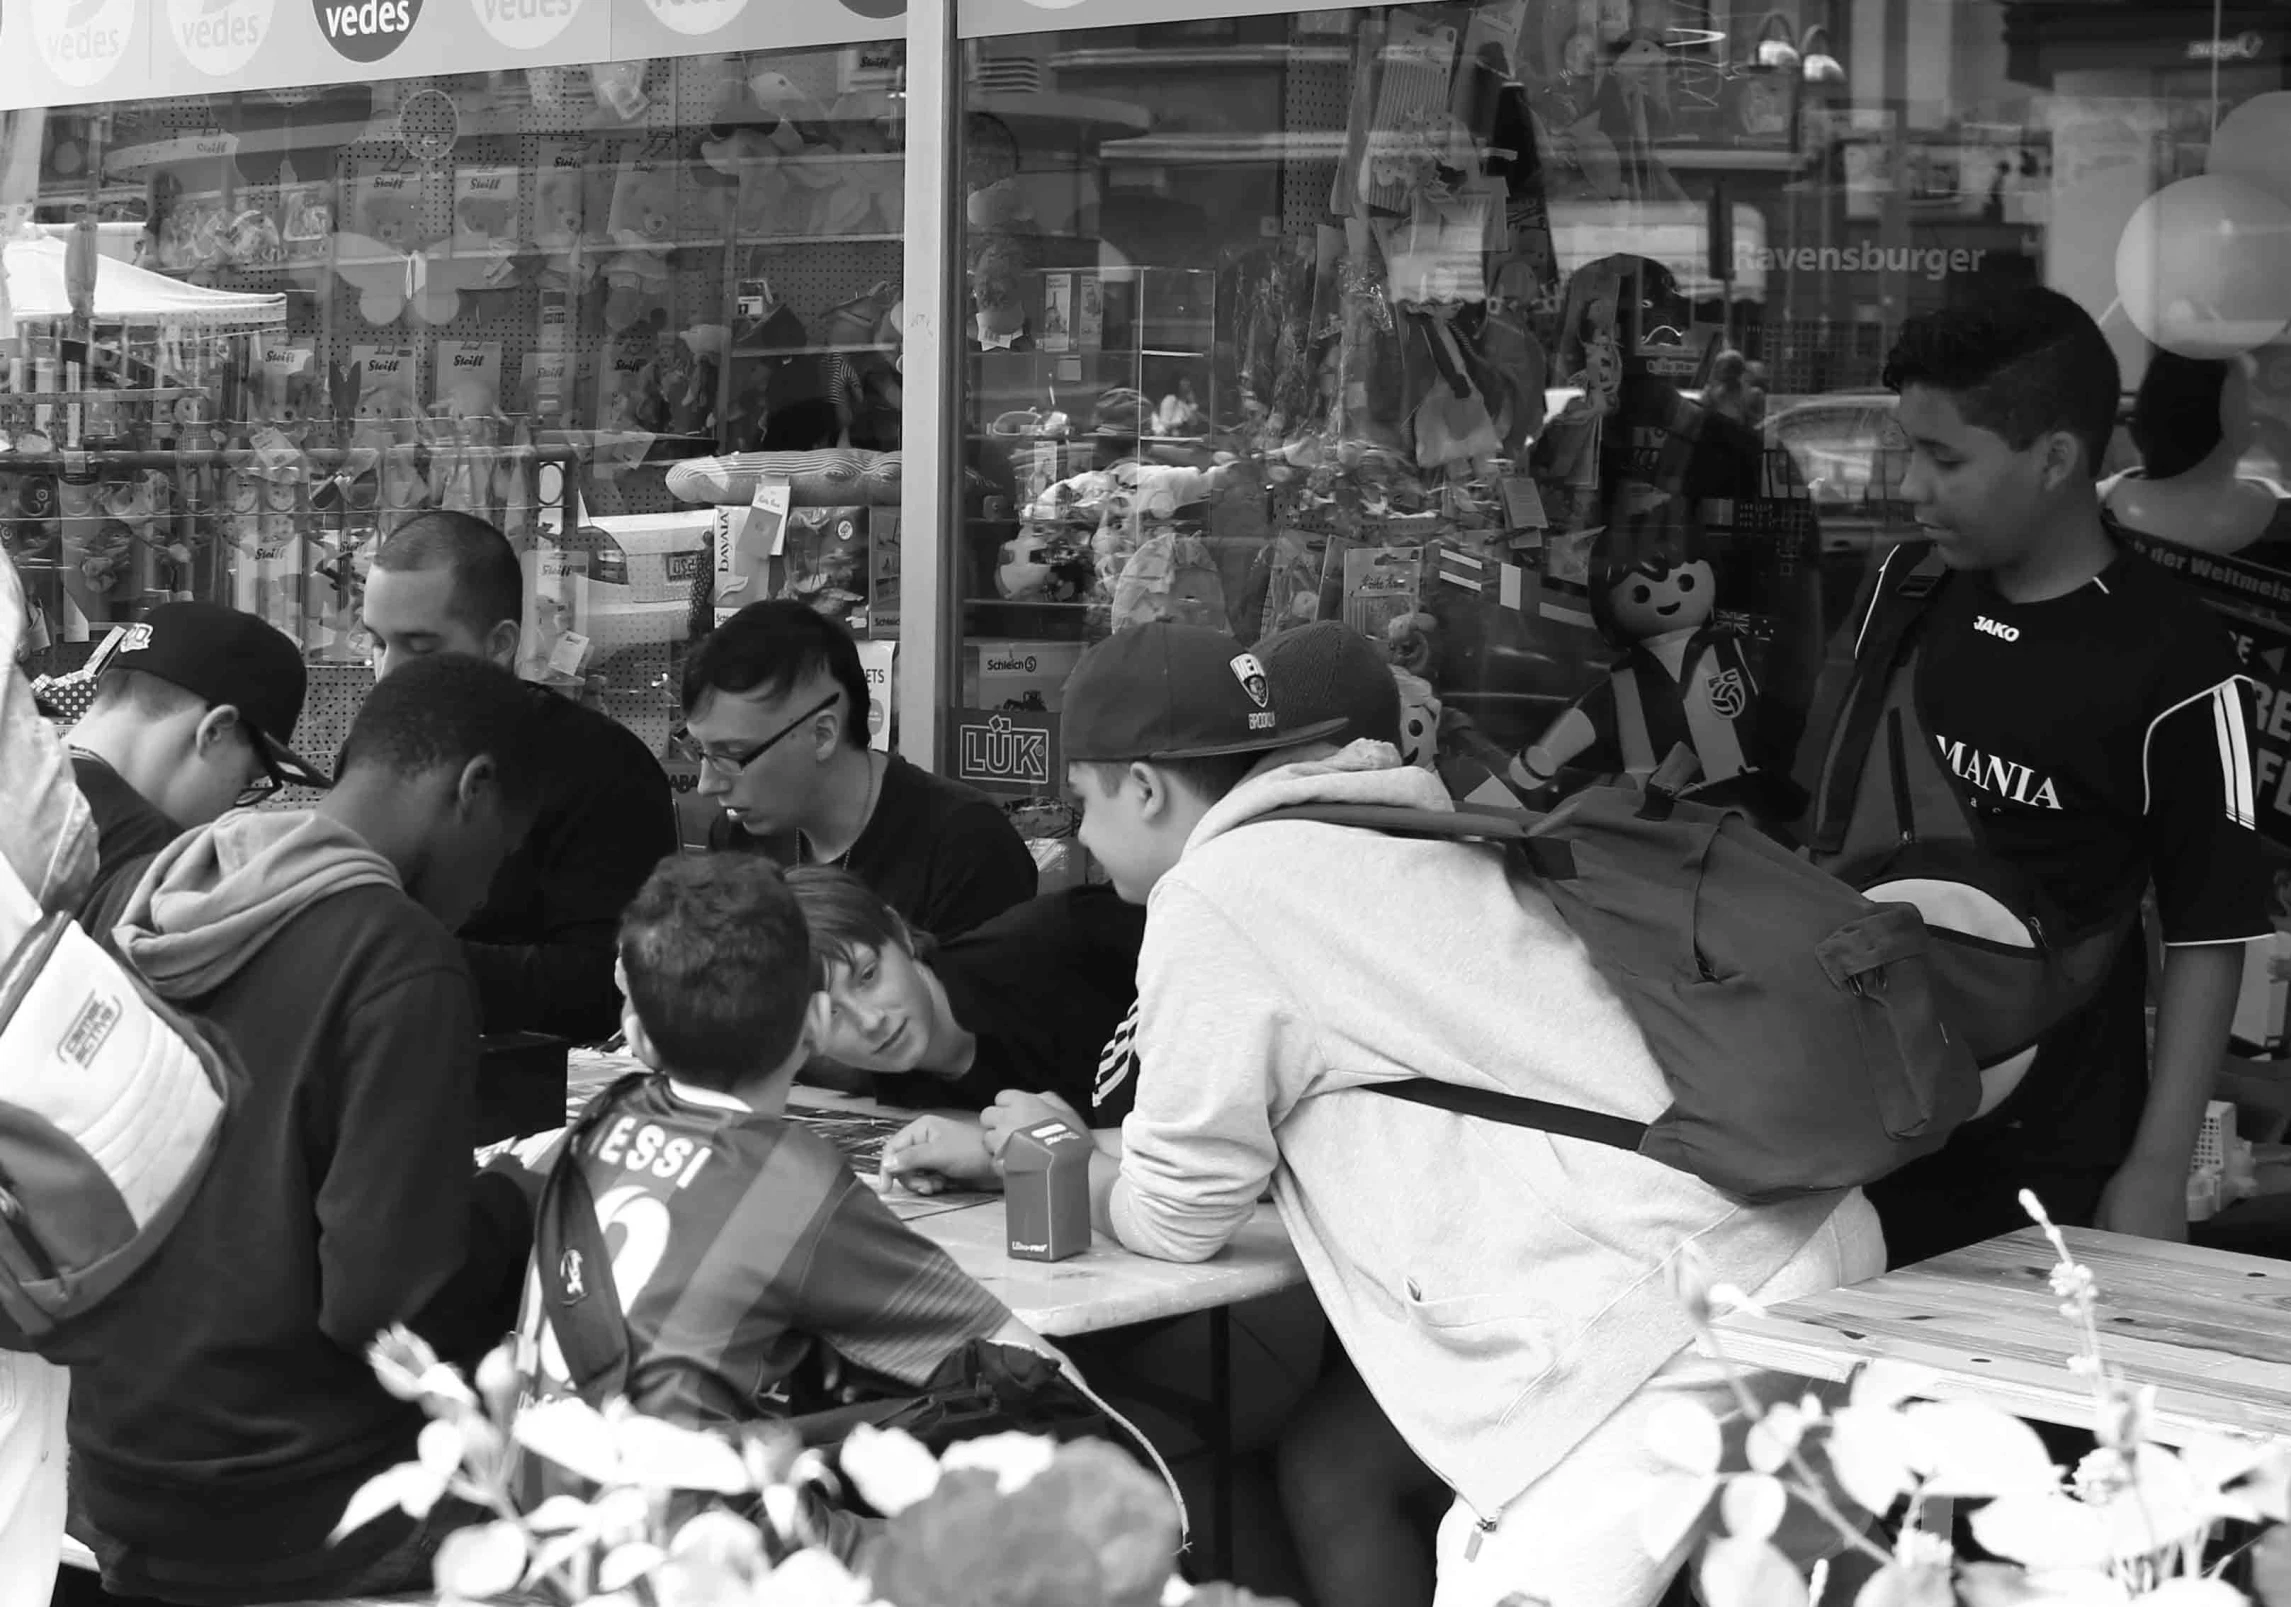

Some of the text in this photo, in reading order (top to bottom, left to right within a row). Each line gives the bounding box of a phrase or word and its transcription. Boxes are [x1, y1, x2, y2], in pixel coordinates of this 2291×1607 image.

[325, 0, 410, 38] vedes
[182, 12, 260, 52] vedes
[48, 24, 121, 60] vedes
[374, 177, 404, 190] Steiff
[470, 178, 501, 190] Steiff
[1735, 239, 1984, 282] Ravensburger
[368, 359, 399, 372] Steiff
[453, 355, 484, 367] Steiff
[255, 547, 285, 560] Steiff
[1974, 615, 2020, 642] JAKO
[987, 659, 1024, 671] Schleich
